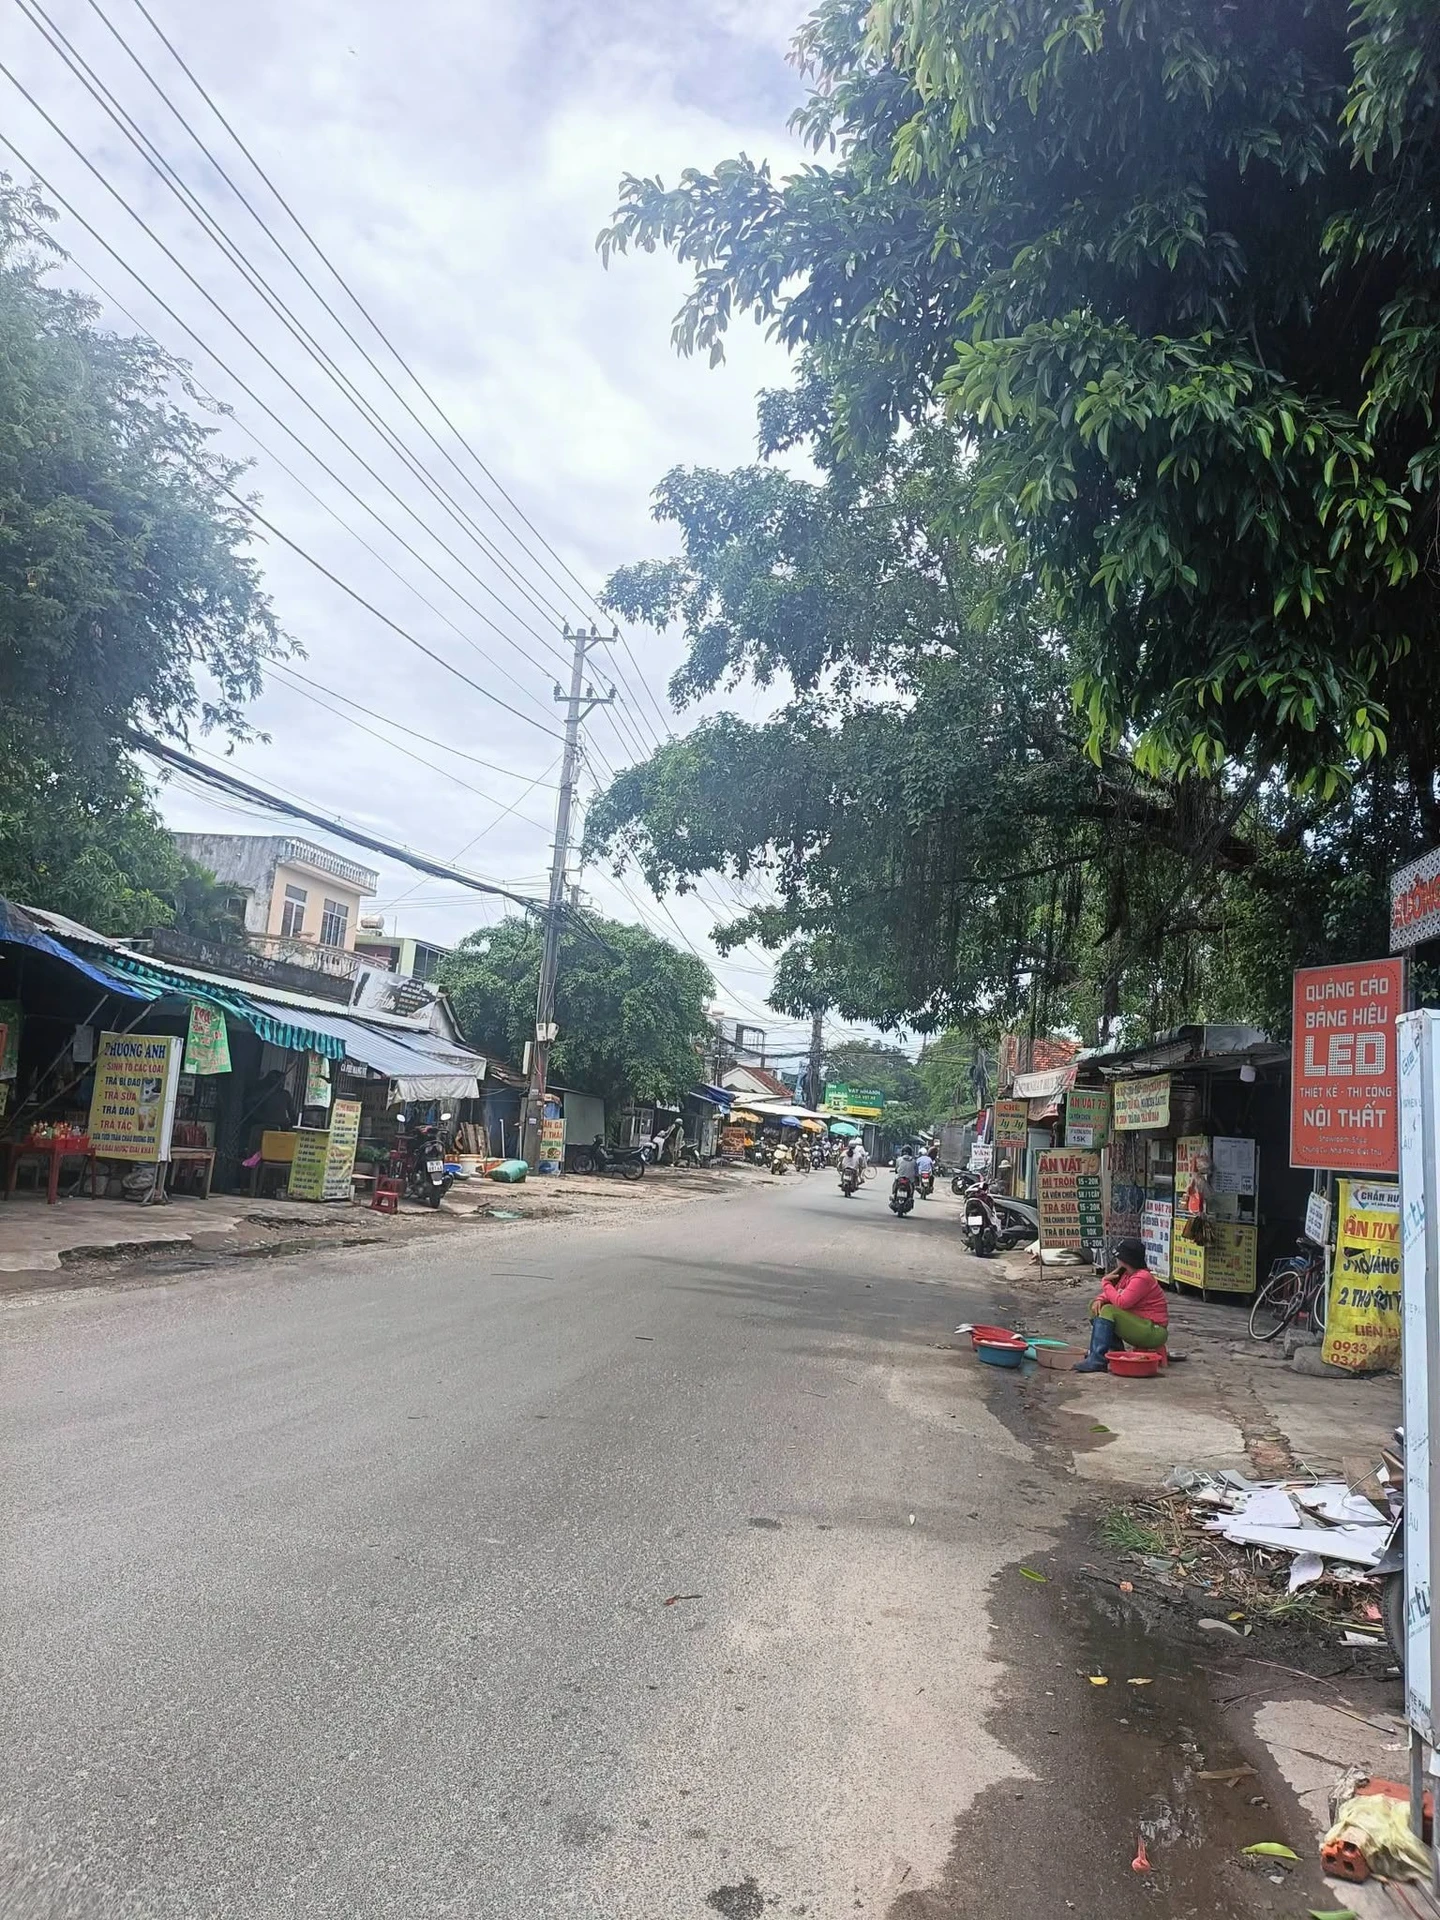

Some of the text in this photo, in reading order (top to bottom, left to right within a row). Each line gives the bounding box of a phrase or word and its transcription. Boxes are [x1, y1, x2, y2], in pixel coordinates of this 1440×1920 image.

[1306, 974, 1389, 1002] QUẢNG CÁO
[1306, 1002, 1388, 1029] BẢNG HIỆU
[1304, 1031, 1386, 1077] LED
[1300, 1083, 1322, 1097] THIẾT
[1326, 1083, 1339, 1097] KẾ
[1347, 1086, 1362, 1097] THI
[1365, 1083, 1392, 1098] CÔNG
[1303, 1100, 1387, 1130] NỘI THẤT
[1039, 1155, 1058, 1172] ĂN
[1059, 1154, 1082, 1175] VẶT
[1338, 1286, 1349, 1306] 2
